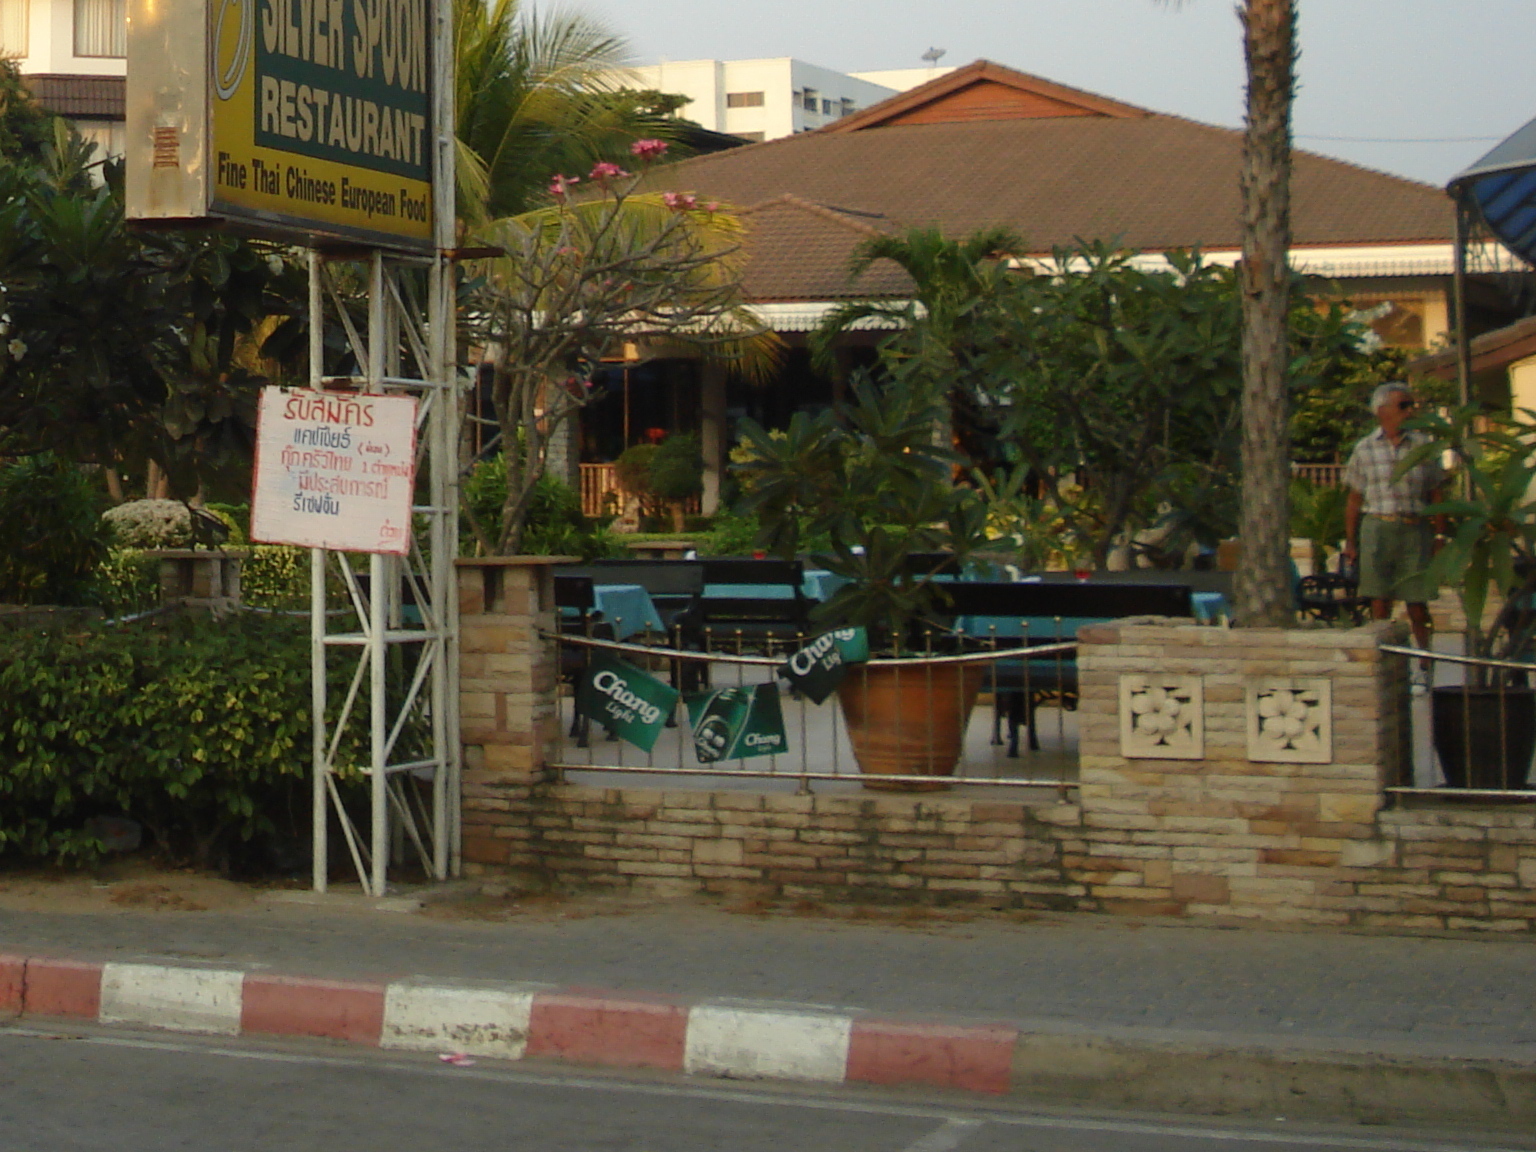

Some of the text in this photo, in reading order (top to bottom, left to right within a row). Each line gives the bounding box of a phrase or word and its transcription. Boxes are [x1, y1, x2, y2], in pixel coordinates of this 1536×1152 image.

[262, 75, 425, 166] RESTAURANT
[218, 151, 426, 222] Fine Thai Chinese European Food
[284, 390, 374, 427] รับสมัคร
[593, 670, 660, 724] Chang
